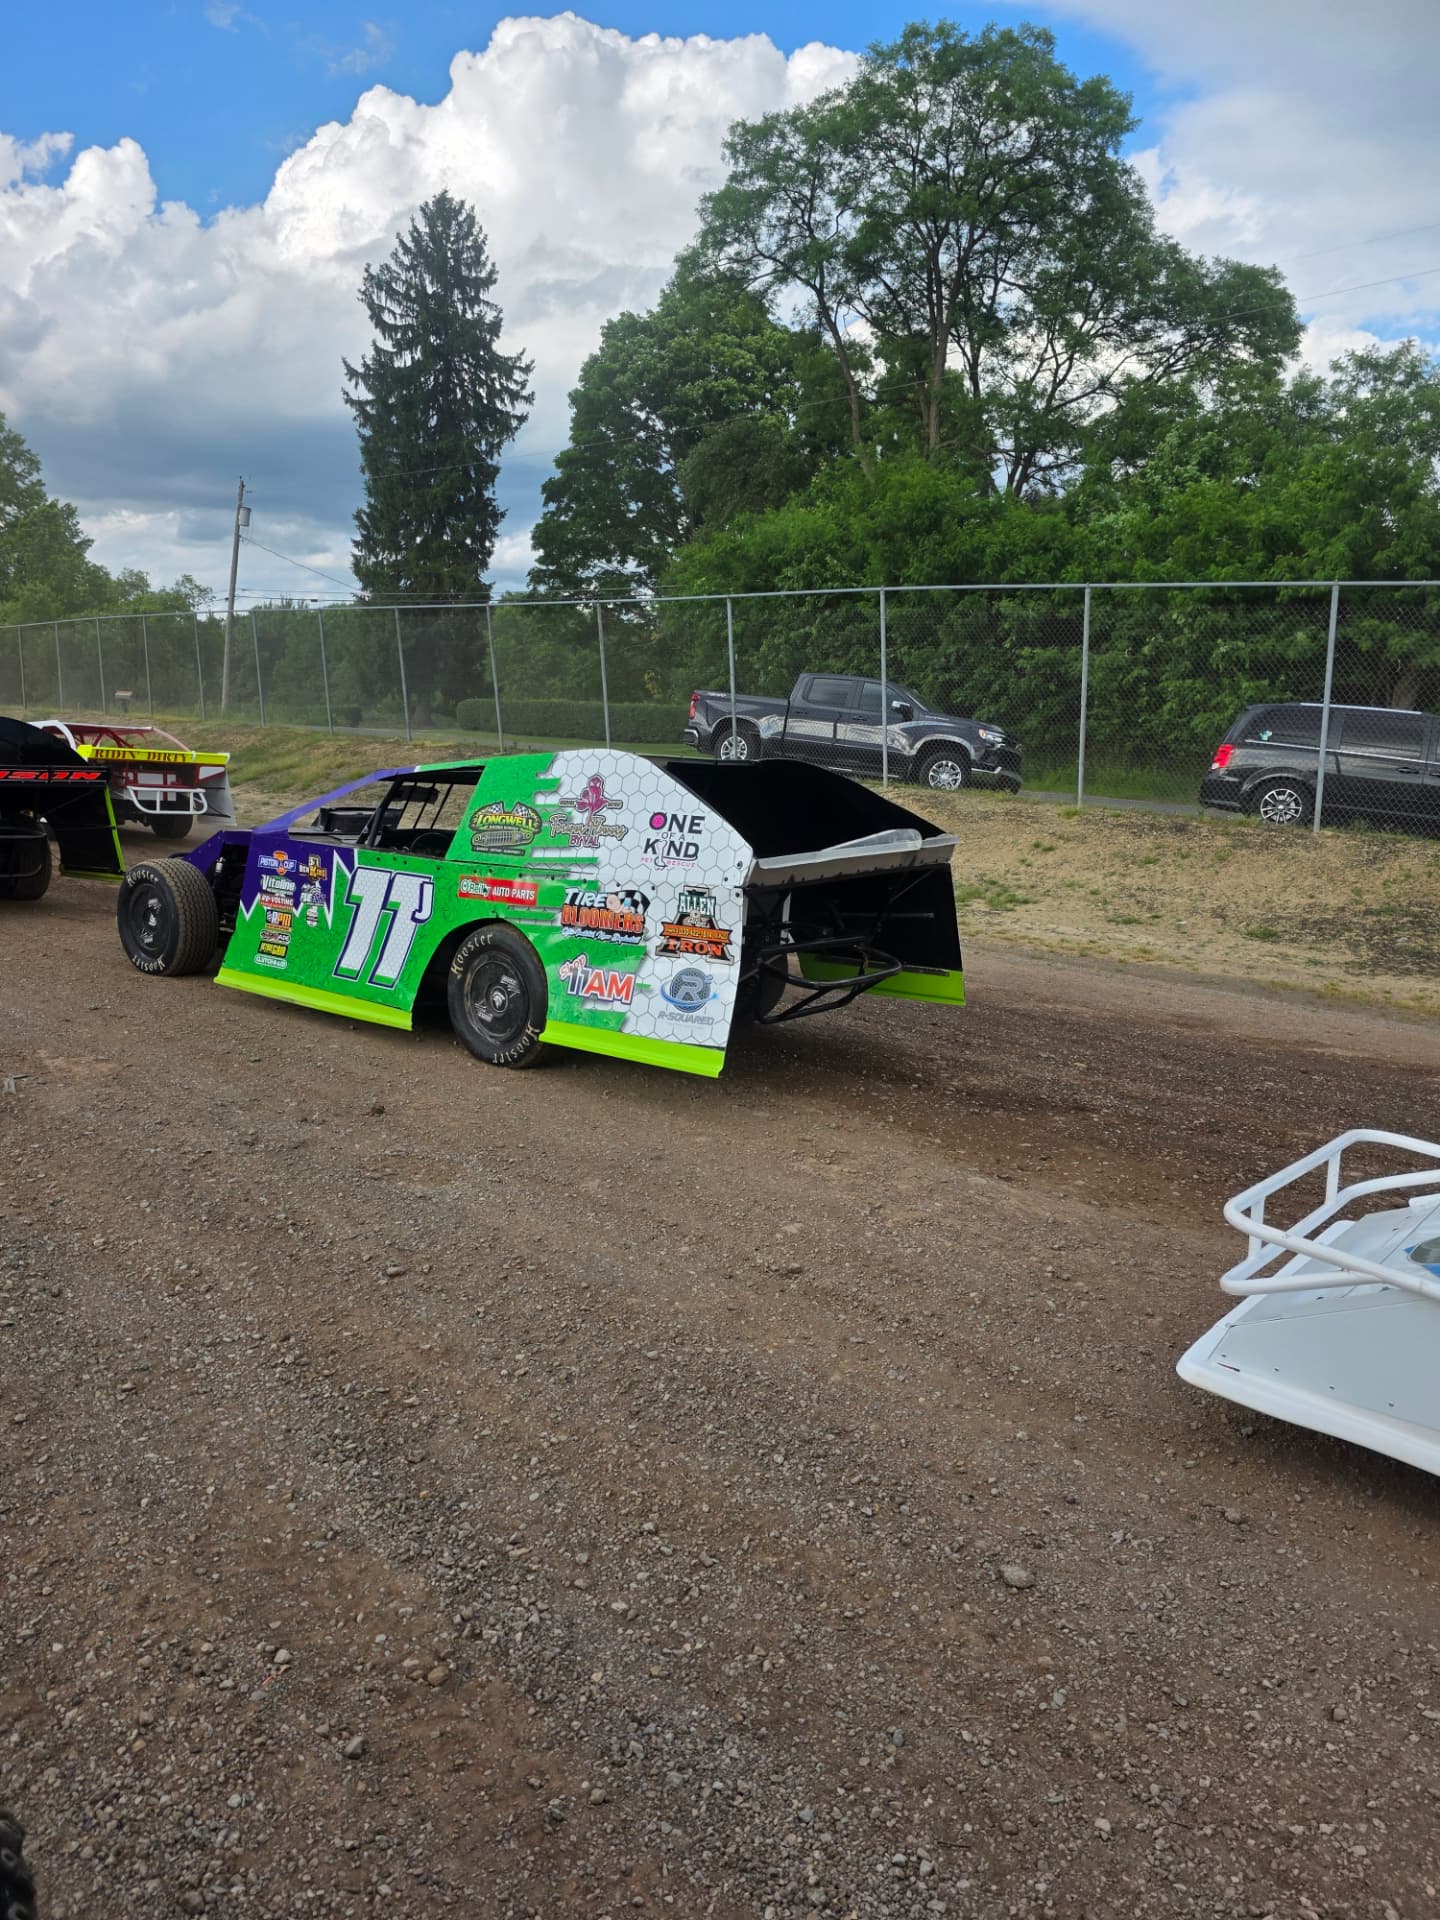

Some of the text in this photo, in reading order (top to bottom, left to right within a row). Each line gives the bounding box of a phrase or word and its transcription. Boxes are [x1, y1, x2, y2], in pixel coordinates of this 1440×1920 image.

[148, 751, 188, 762] DIRTY
[476, 814, 535, 832] LONGWELL
[649, 812, 706, 834] ONE
[661, 832, 677, 840] OF
[283, 860, 295, 870] CUP
[492, 887, 510, 897] AUTO
[511, 889, 535, 900] PARTS
[565, 887, 608, 907] TIRE
[679, 894, 715, 916] ALLEN
[667, 938, 724, 956] IRON
[657, 1011, 715, 1025] R-SQUARED
